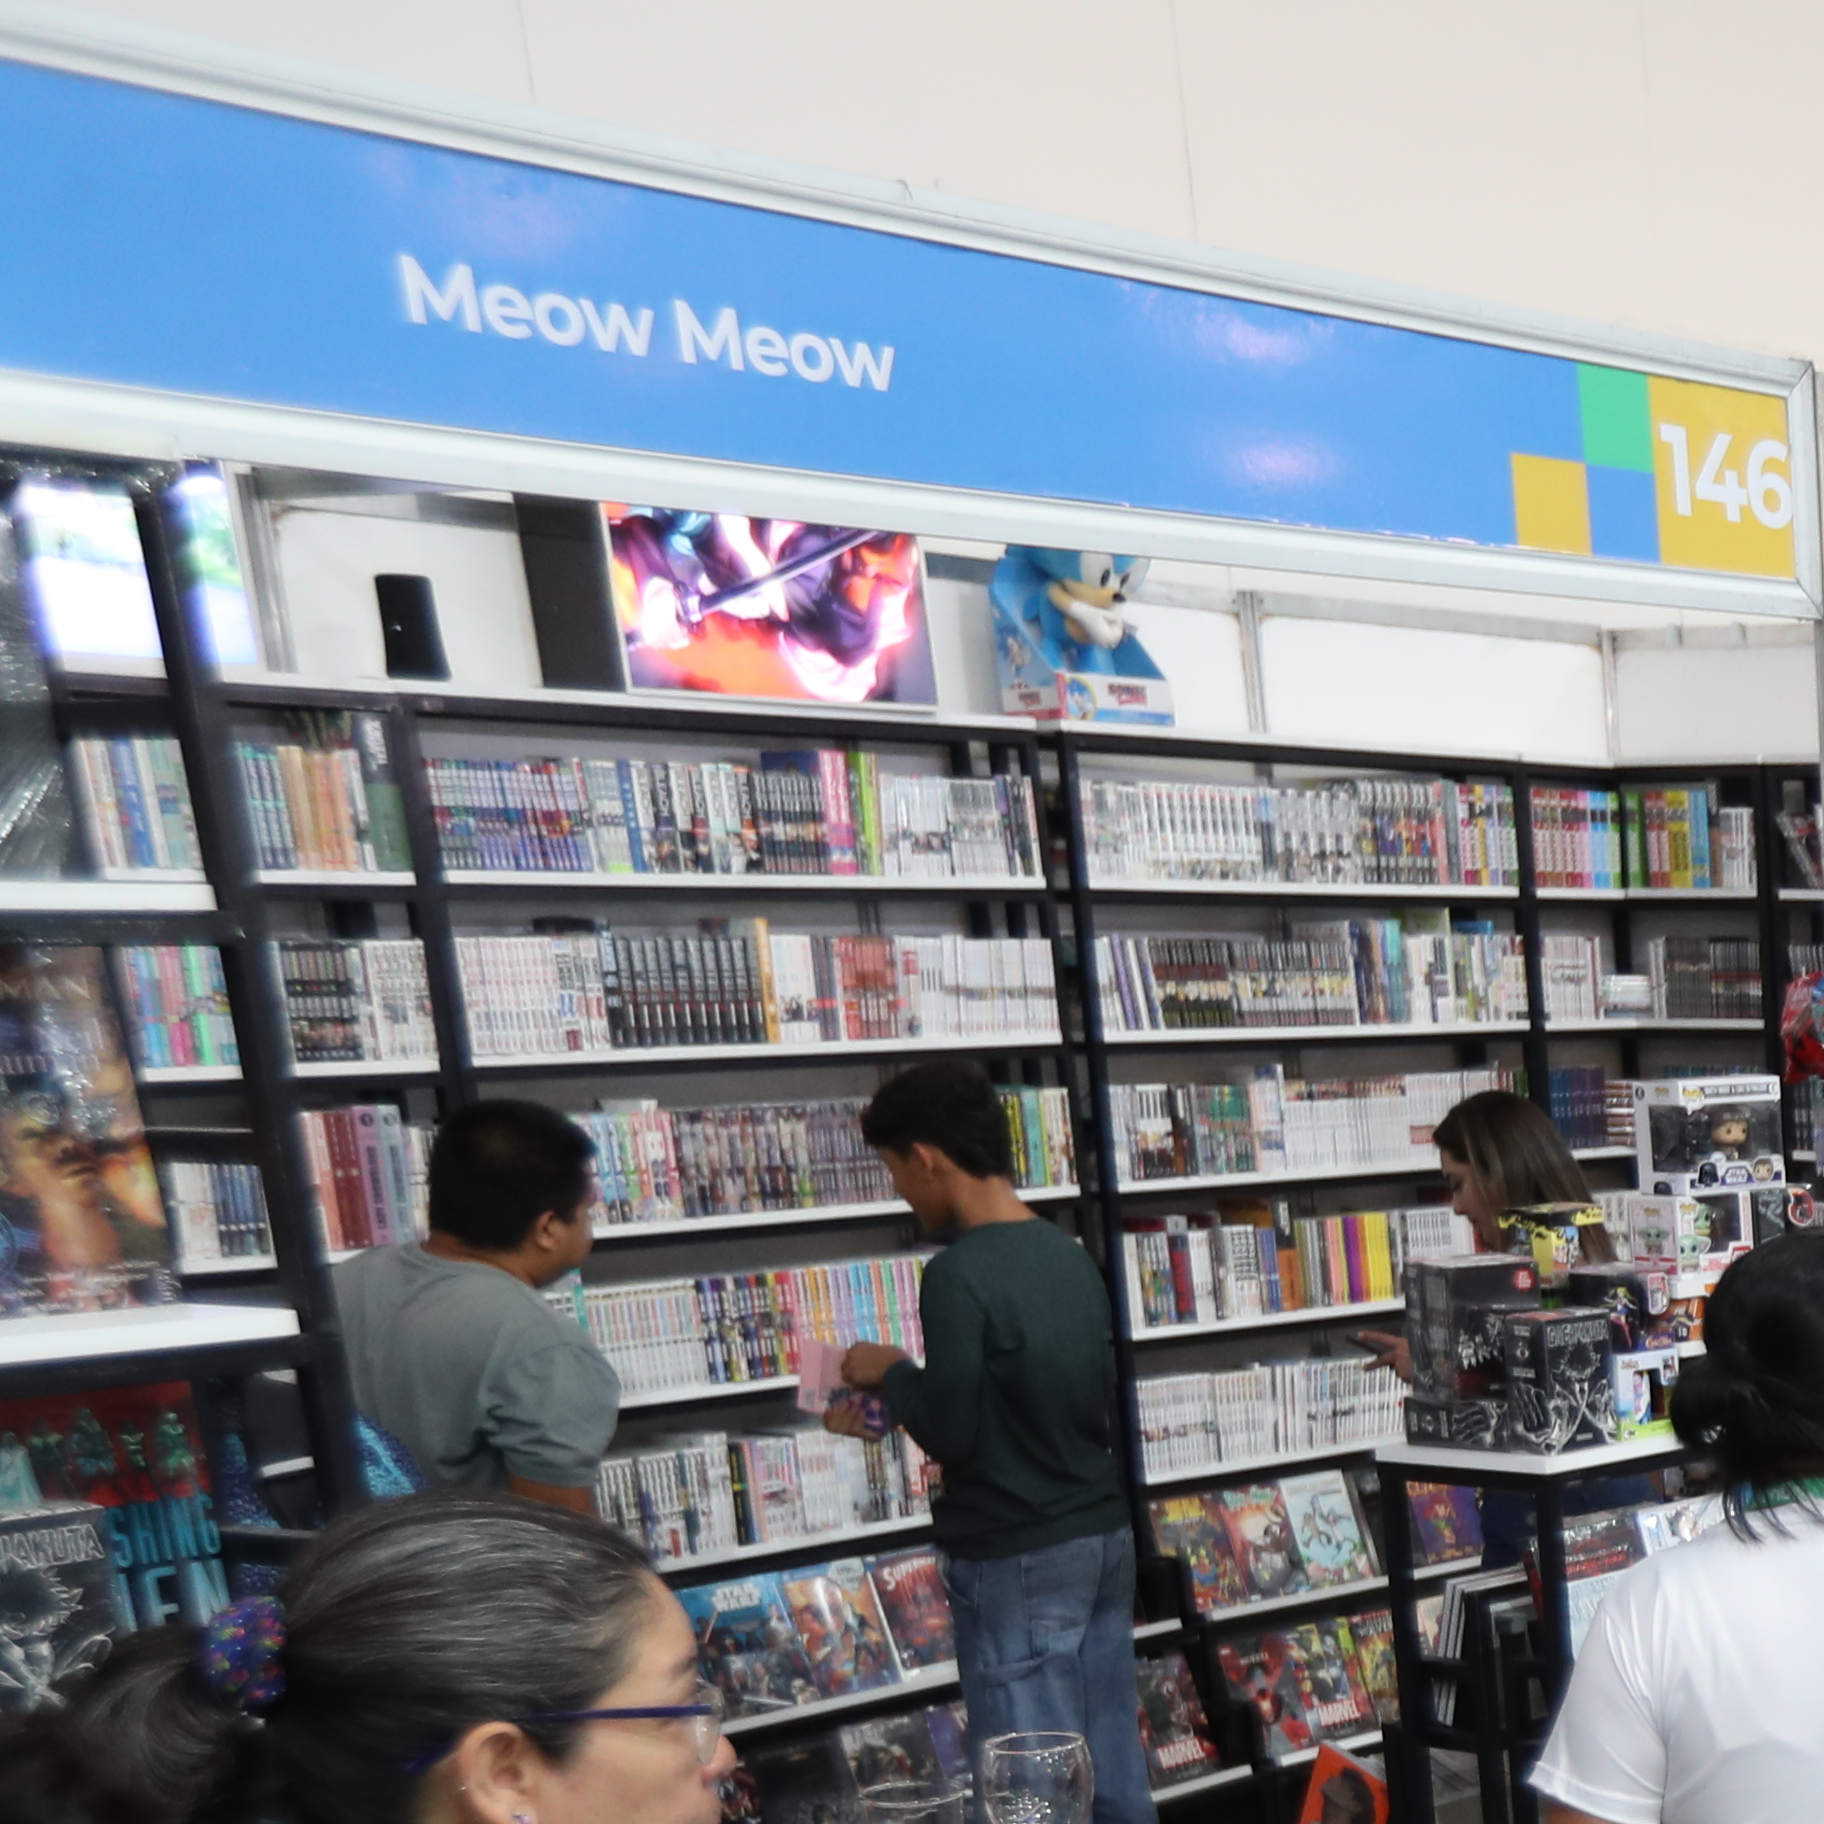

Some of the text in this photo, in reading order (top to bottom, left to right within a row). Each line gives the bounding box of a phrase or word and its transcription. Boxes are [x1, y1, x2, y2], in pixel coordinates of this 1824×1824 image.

[397, 253, 895, 393] Meow Meow
[1660, 423, 1795, 529] 146
[1317, 1699, 1361, 1727] MARVEL
[1157, 1738, 1206, 1770] MARVEL
